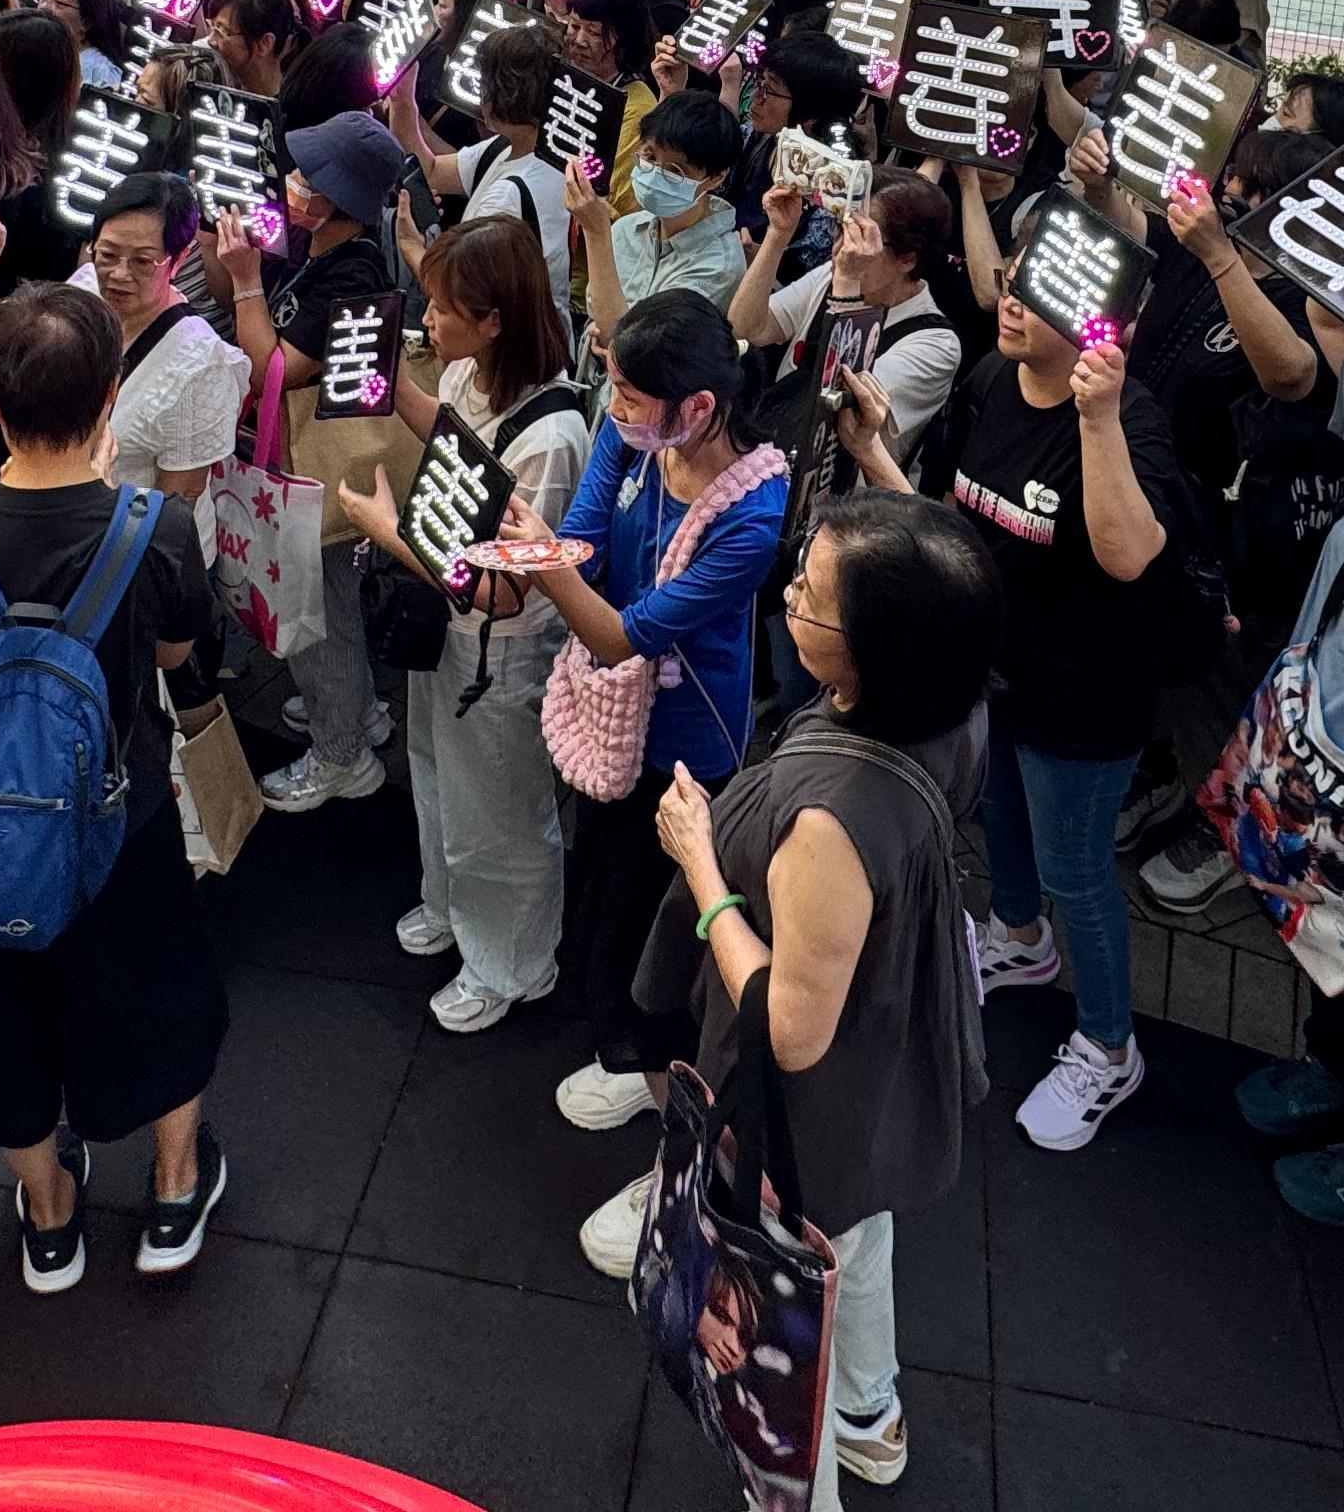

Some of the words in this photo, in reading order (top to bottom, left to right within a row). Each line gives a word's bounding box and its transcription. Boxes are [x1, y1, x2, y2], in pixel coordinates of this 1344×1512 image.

[544, 75, 603, 166] 姜
[899, 17, 1019, 156] 姜
[1109, 41, 1226, 198] 姜
[1029, 212, 1120, 331] 姜
[324, 305, 384, 403] 姜
[412, 433, 490, 582] 姜
